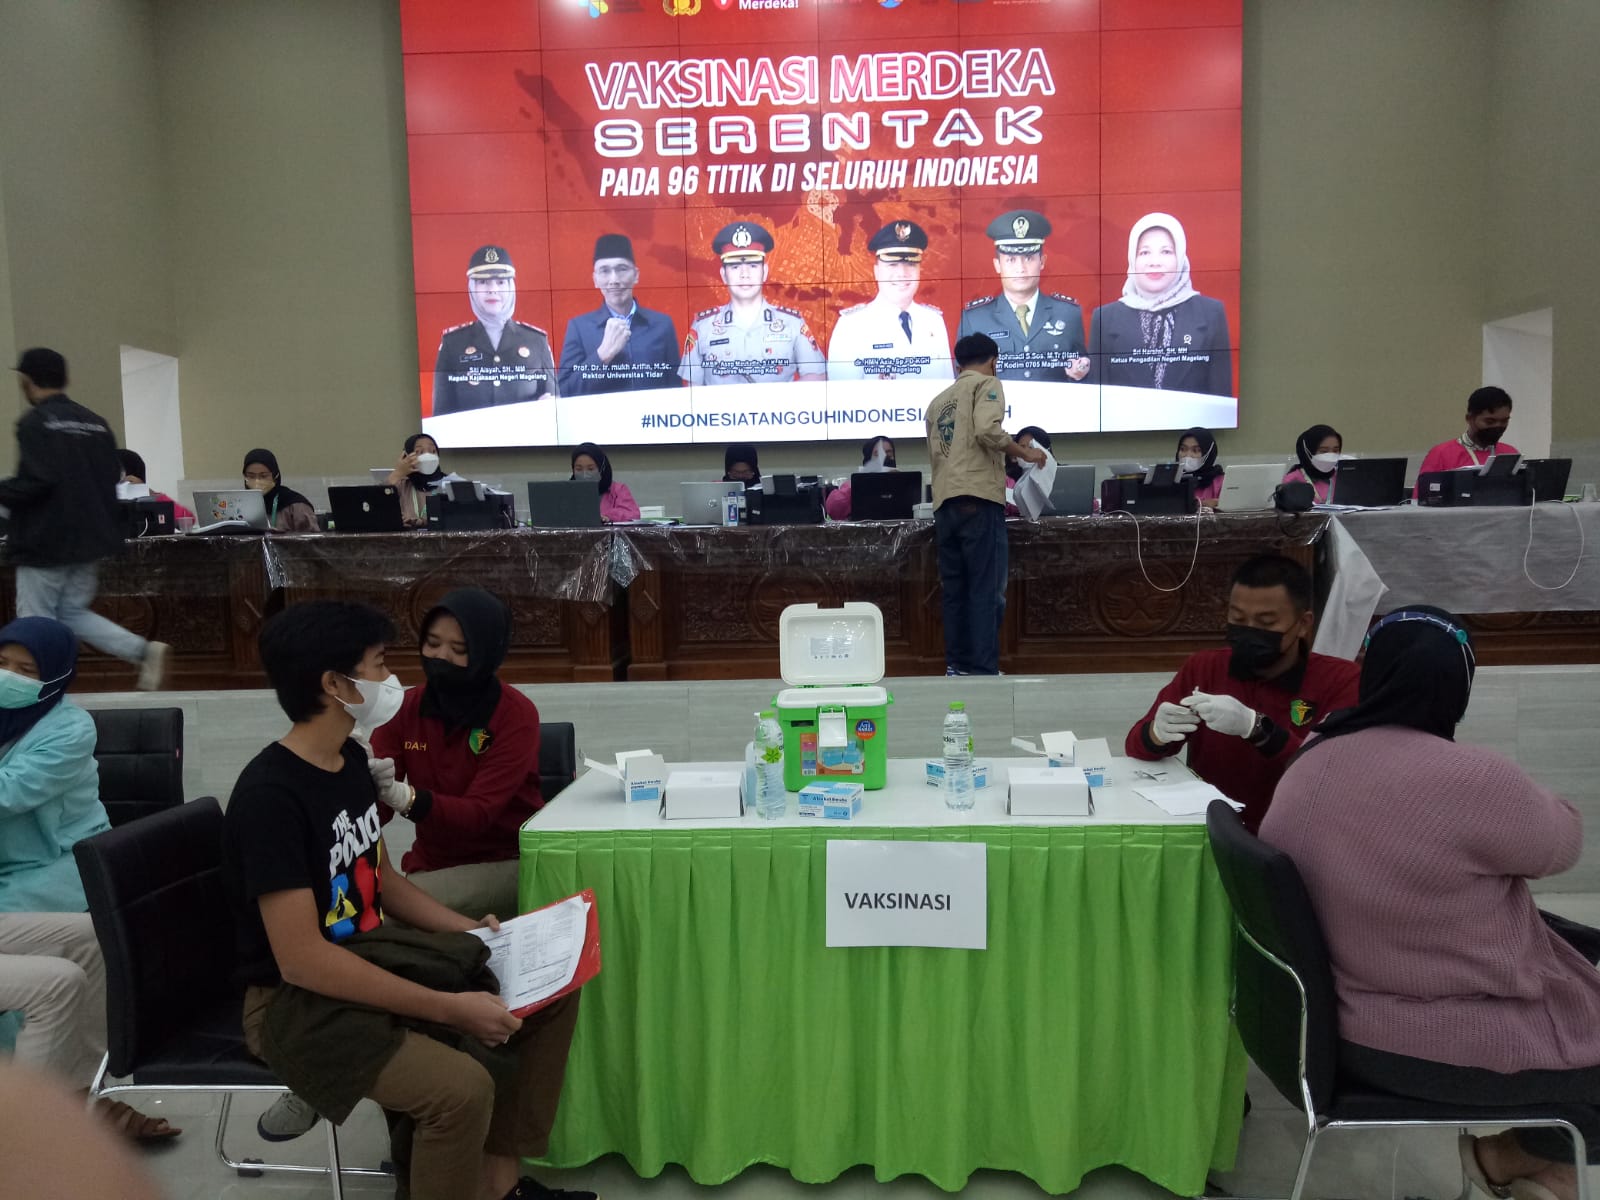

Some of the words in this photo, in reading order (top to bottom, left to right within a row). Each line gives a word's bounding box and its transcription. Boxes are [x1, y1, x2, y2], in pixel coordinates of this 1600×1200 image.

[738, 0, 799, 10] Merdeka!
[584, 55, 819, 110] VAKSINASI
[829, 47, 1056, 103] MERDEKA
[594, 105, 1043, 158] SERENTAK
[598, 166, 660, 197] PADA
[667, 165, 700, 196] 96
[706, 163, 766, 194] TITIK
[771, 162, 796, 193] DI
[800, 158, 909, 192] SELURUH
[912, 154, 1039, 188] INDONESIA
[329, 802, 382, 880] POLIC
[332, 809, 352, 841] THE
[844, 892, 951, 911] VAKSINASI
